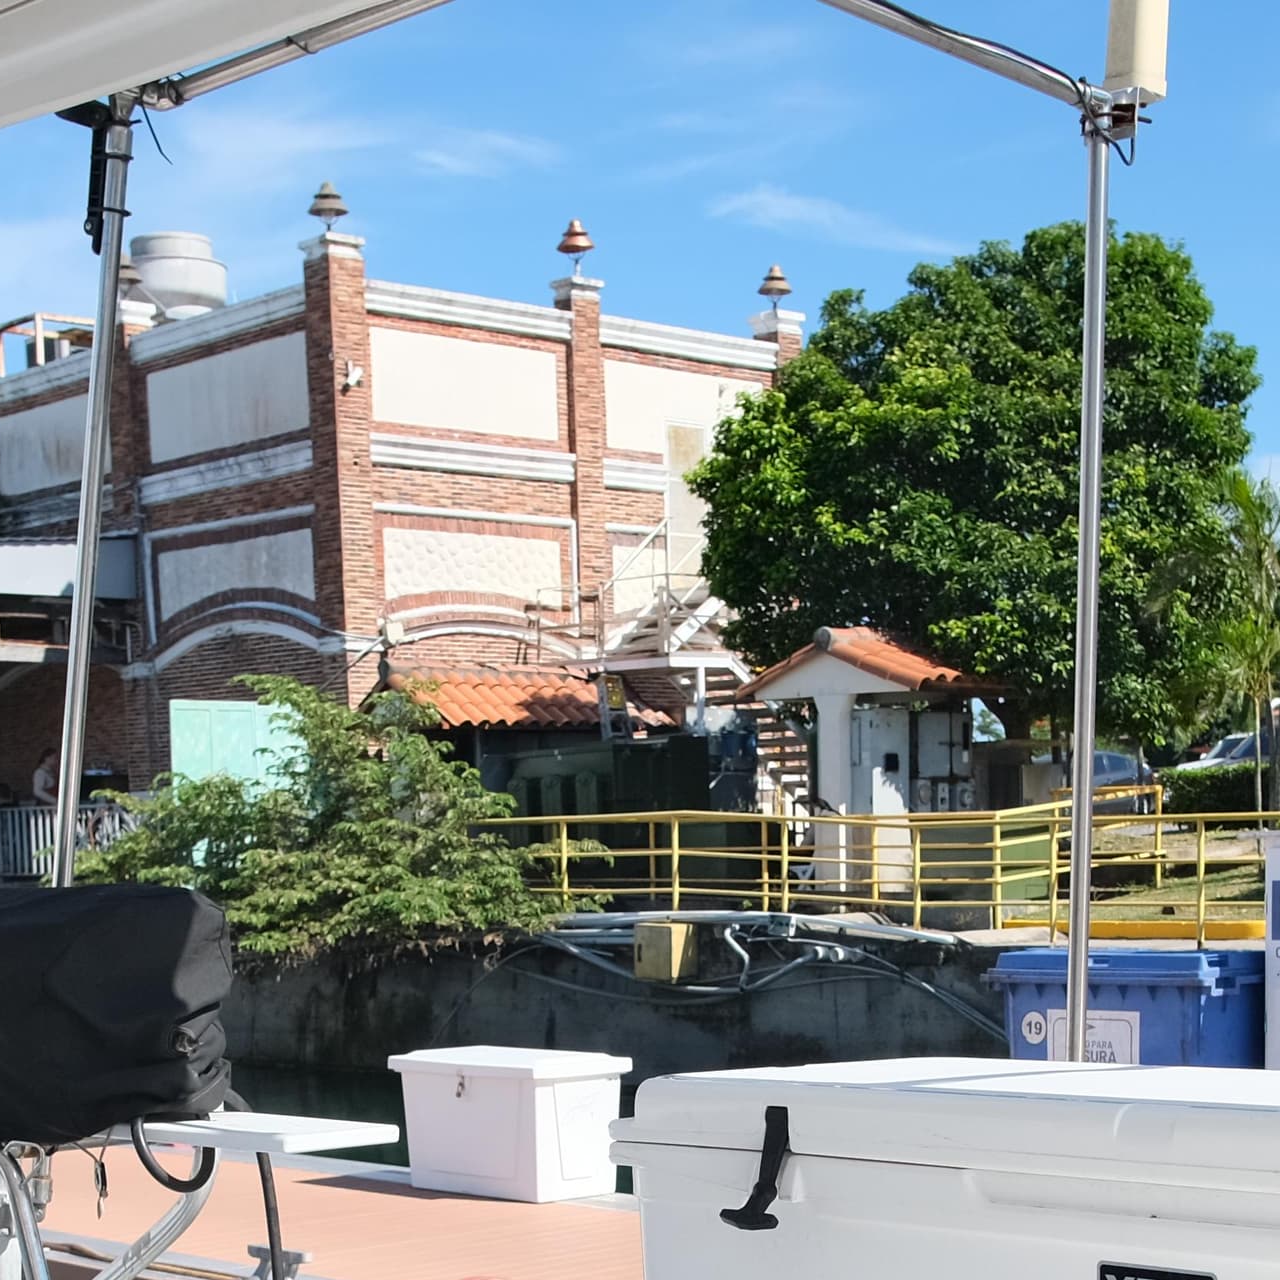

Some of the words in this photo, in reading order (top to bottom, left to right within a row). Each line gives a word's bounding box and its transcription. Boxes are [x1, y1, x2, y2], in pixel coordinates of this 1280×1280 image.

[1026, 1020, 1043, 1036] 19
[1091, 1040, 1113, 1049] PARA
[1084, 1050, 1117, 1064] SURA
